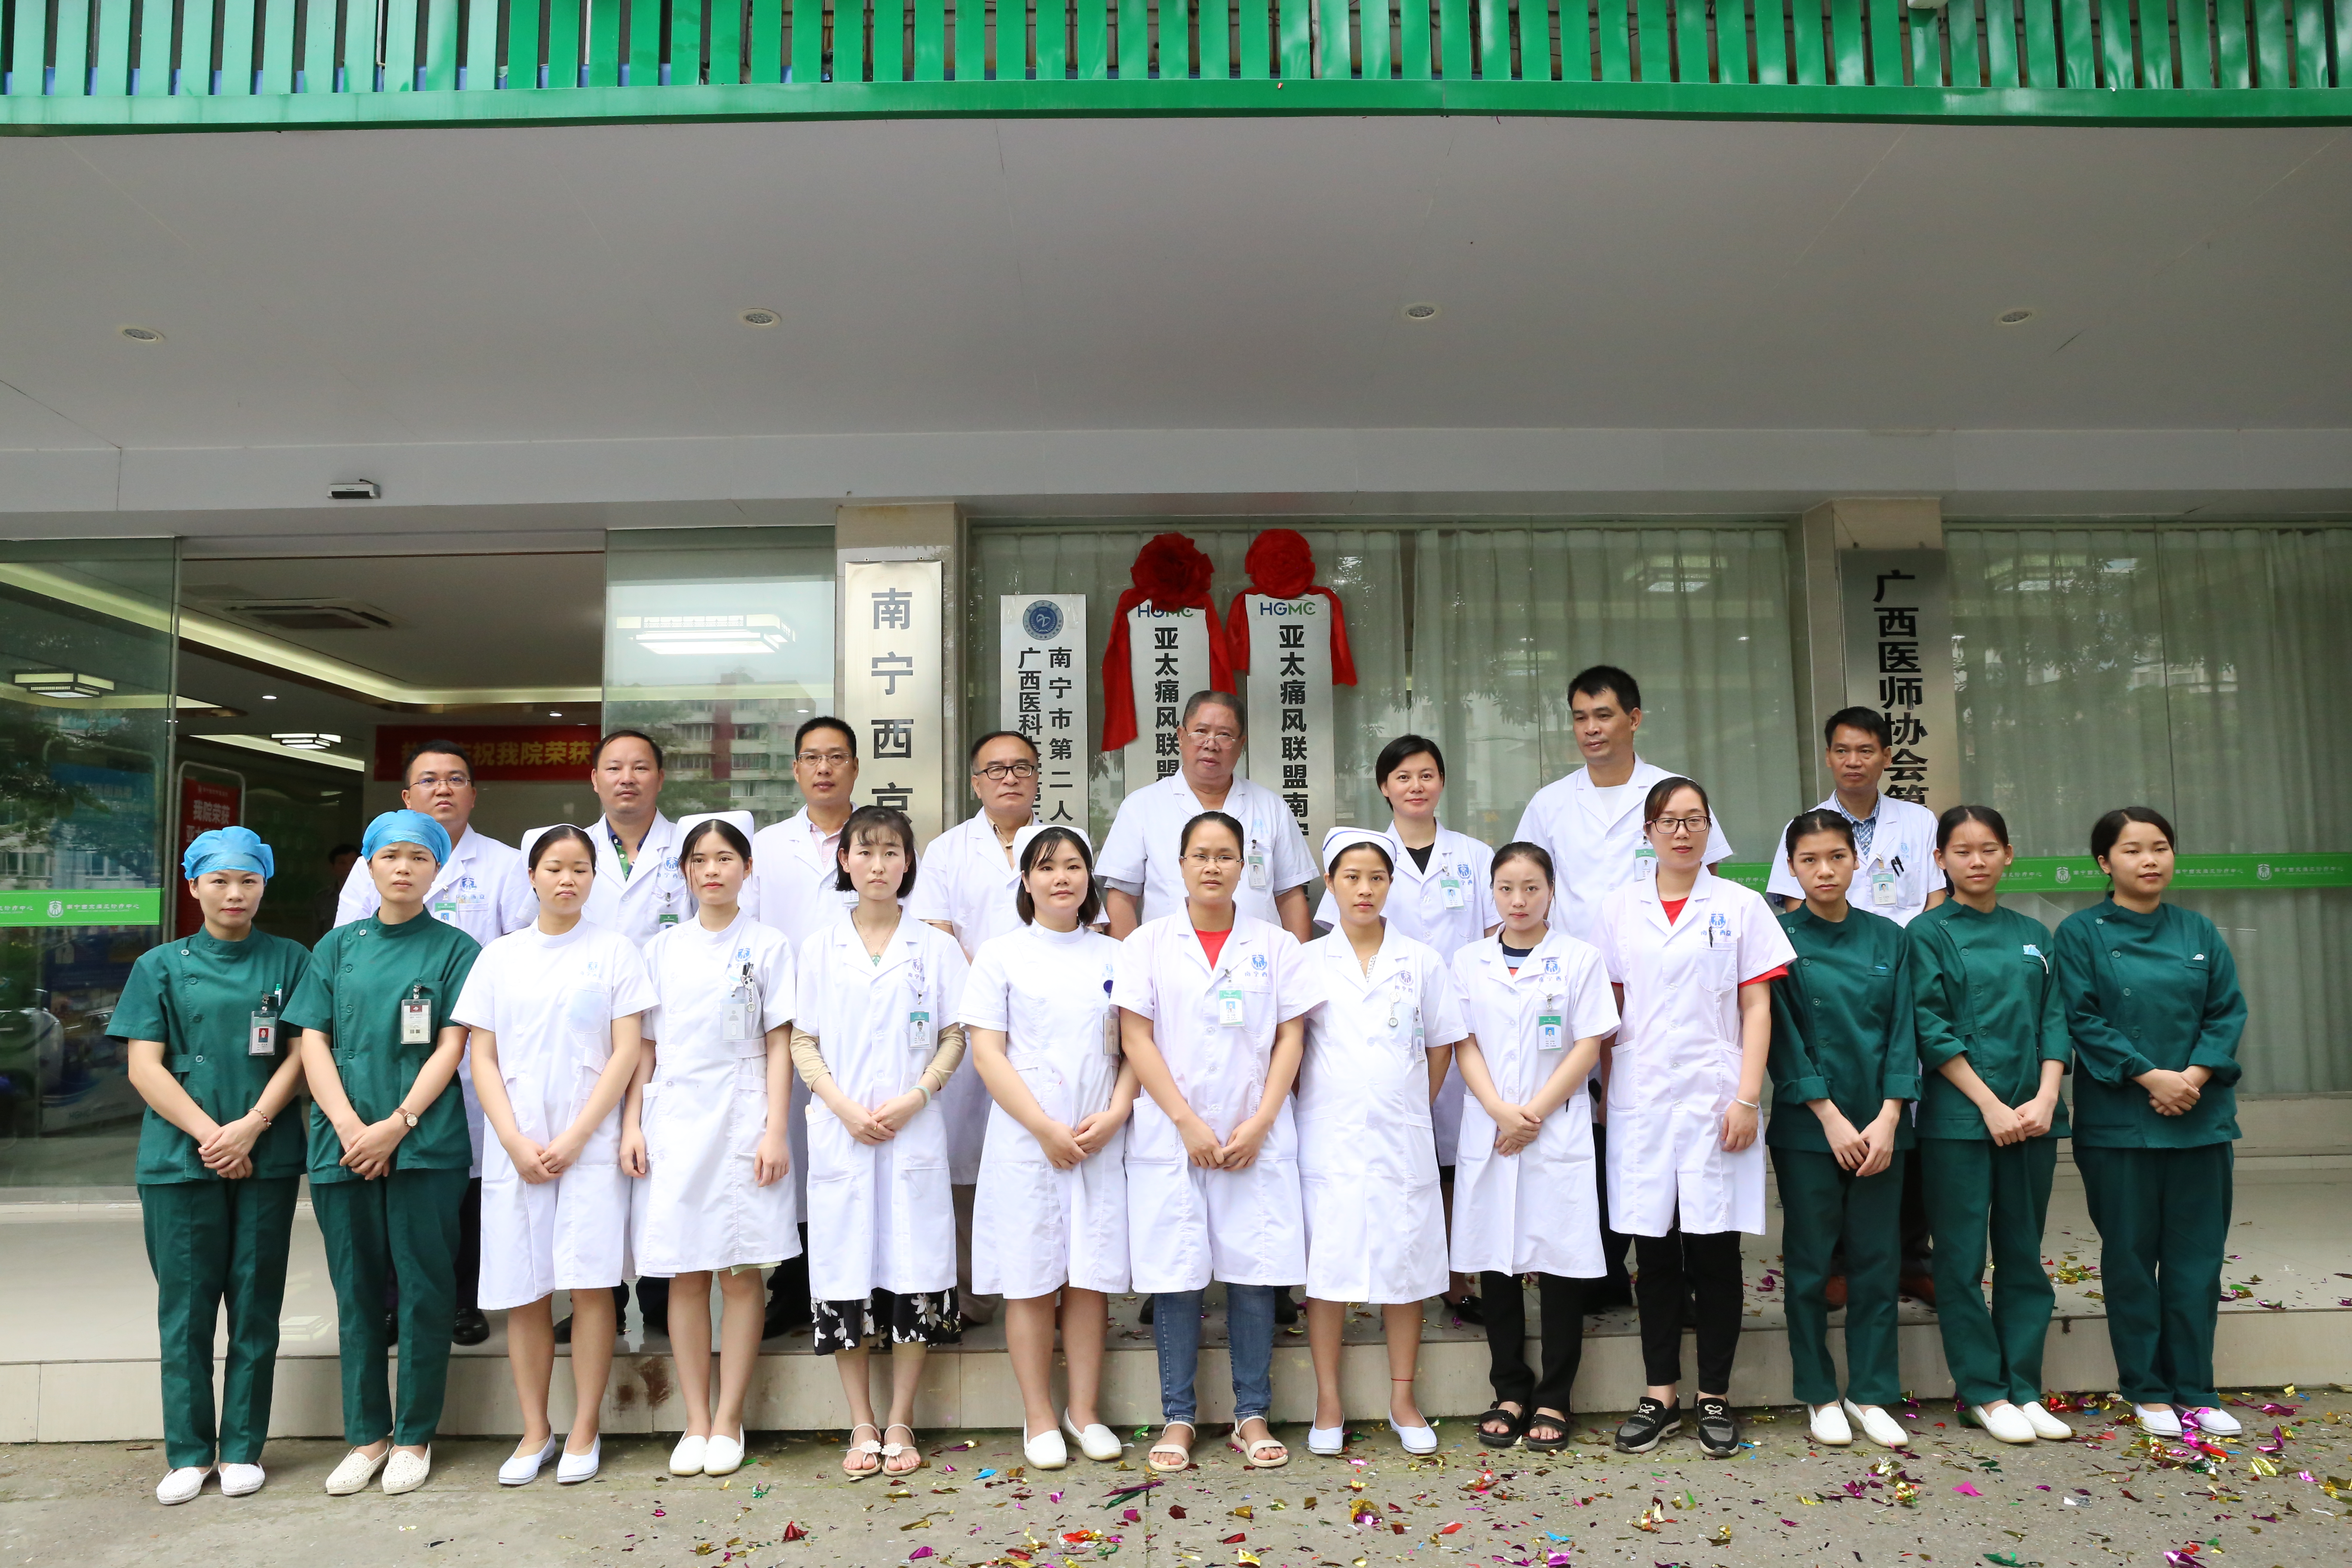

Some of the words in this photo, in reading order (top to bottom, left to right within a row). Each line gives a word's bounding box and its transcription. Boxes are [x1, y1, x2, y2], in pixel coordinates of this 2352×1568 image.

[1260, 601, 1316, 616] HGMC
[1048, 646, 1073, 822] 南宁市第二人
[1279, 624, 1309, 836] 亚太痛风联盟南
